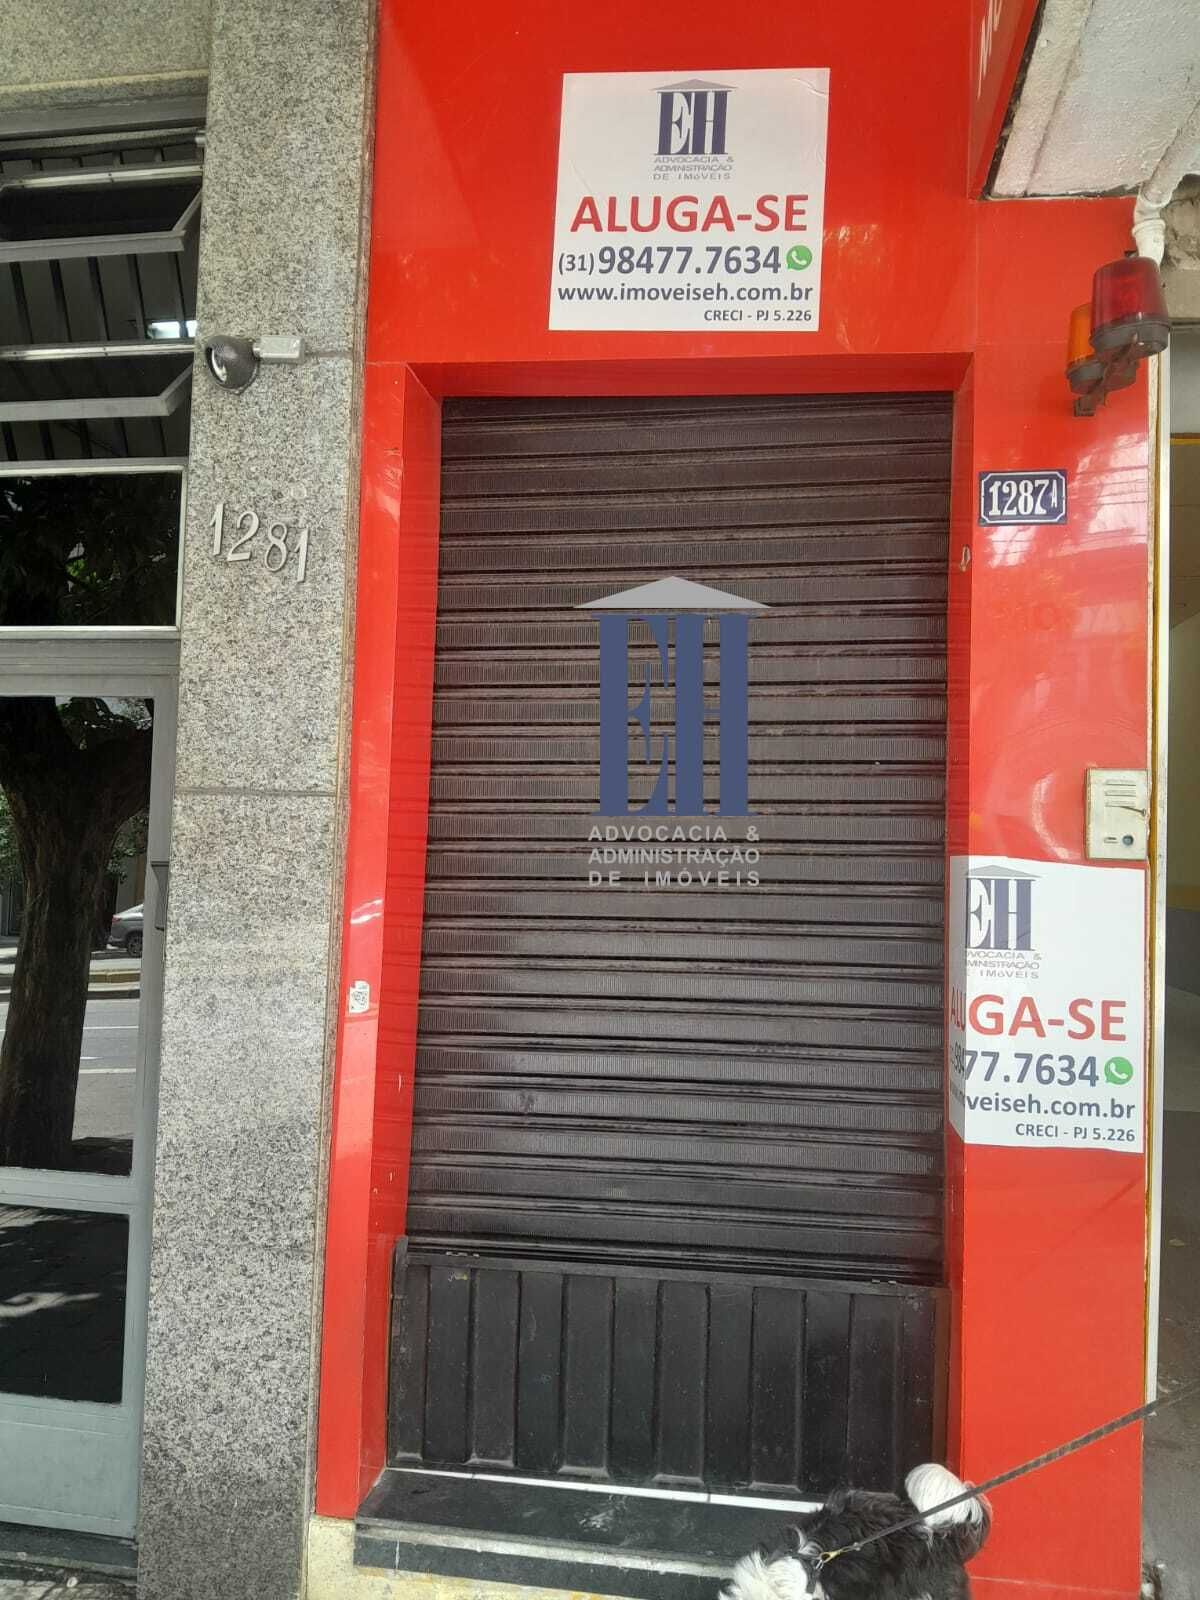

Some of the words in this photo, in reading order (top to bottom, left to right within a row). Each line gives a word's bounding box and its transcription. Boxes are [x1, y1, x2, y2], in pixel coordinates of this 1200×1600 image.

[654, 90, 732, 155] EH
[653, 173, 669, 181] DE
[570, 194, 809, 232] ALUGA-SE
[558, 253, 595, 275] (31)
[598, 246, 782, 274] 98477.7634
[558, 283, 813, 301] www.imoveiseh.com.br
[704, 310, 743, 321] CRECI
[756, 310, 770, 322] PJ
[773, 310, 812, 321] 5.226
[209, 502, 311, 584] 1281
[965, 877, 1037, 951] EH
[966, 950, 1025, 960] VOCACIA
[966, 959, 1040, 969] MINISTRAÇÃO
[1015, 1123, 1059, 1137] CRECI
[1073, 1126, 1088, 1140] PJ
[1092, 1127, 1136, 1142] 5.226
